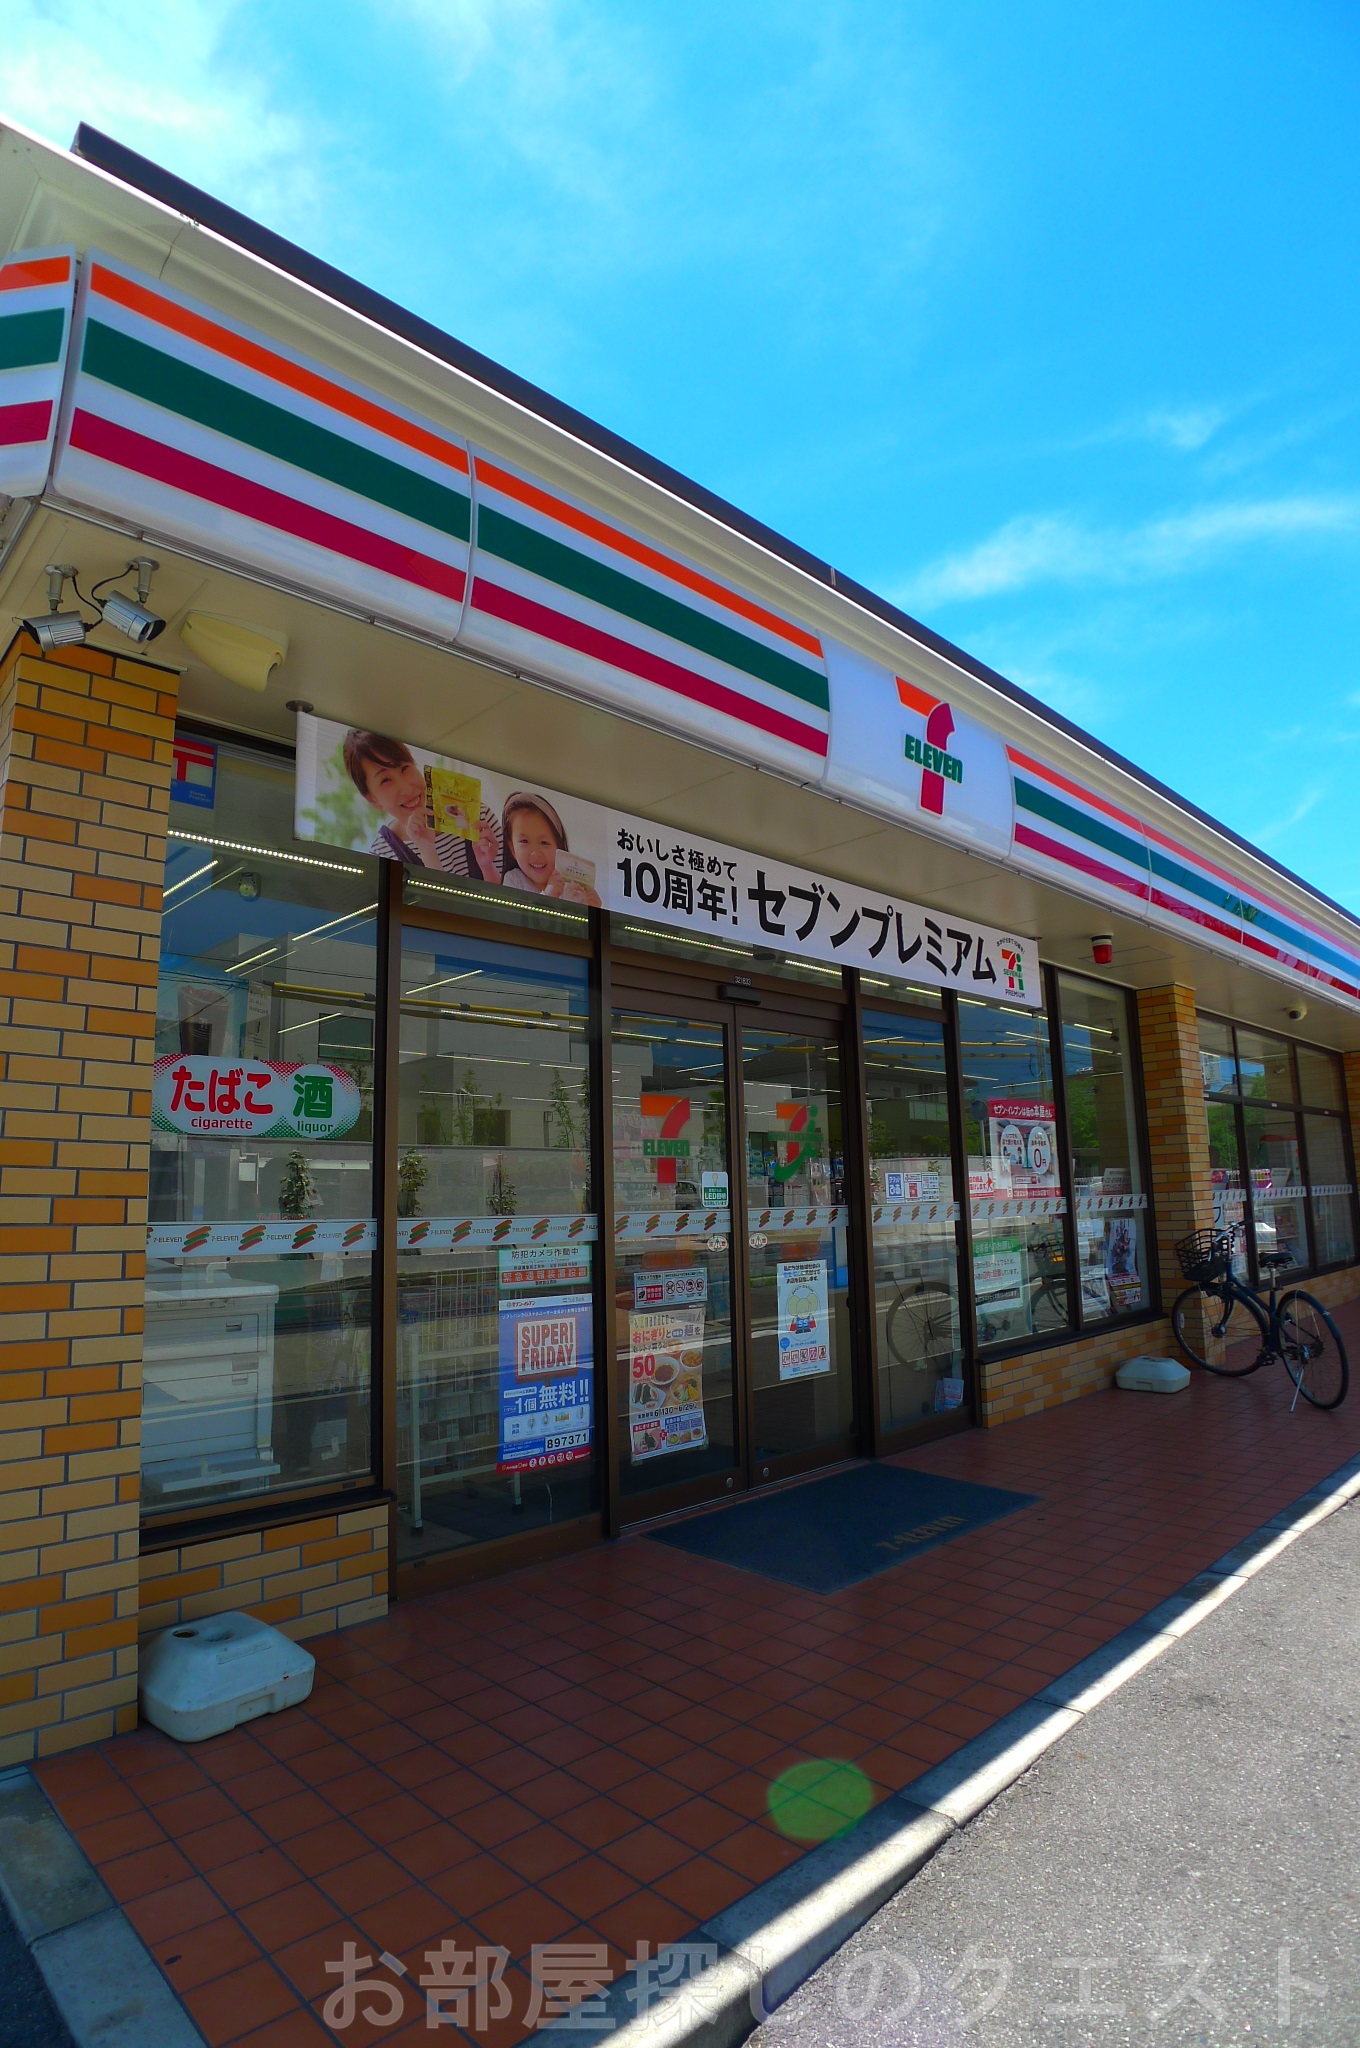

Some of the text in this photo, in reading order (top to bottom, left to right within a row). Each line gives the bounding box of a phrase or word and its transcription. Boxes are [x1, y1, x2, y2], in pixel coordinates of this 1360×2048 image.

[617, 828, 738, 881] おいしさ極めて
[748, 869, 997, 985] セブンプレミアム
[170, 1065, 334, 1119] たばこ 酒
[190, 1115, 334, 1133] cigarette liquor
[511, 1247, 579, 1259] 防犯カメラ作動中
[521, 1344, 574, 1371] FRIDAY
[633, 1353, 655, 1378] 50
[547, 1433, 587, 1449] 897371
